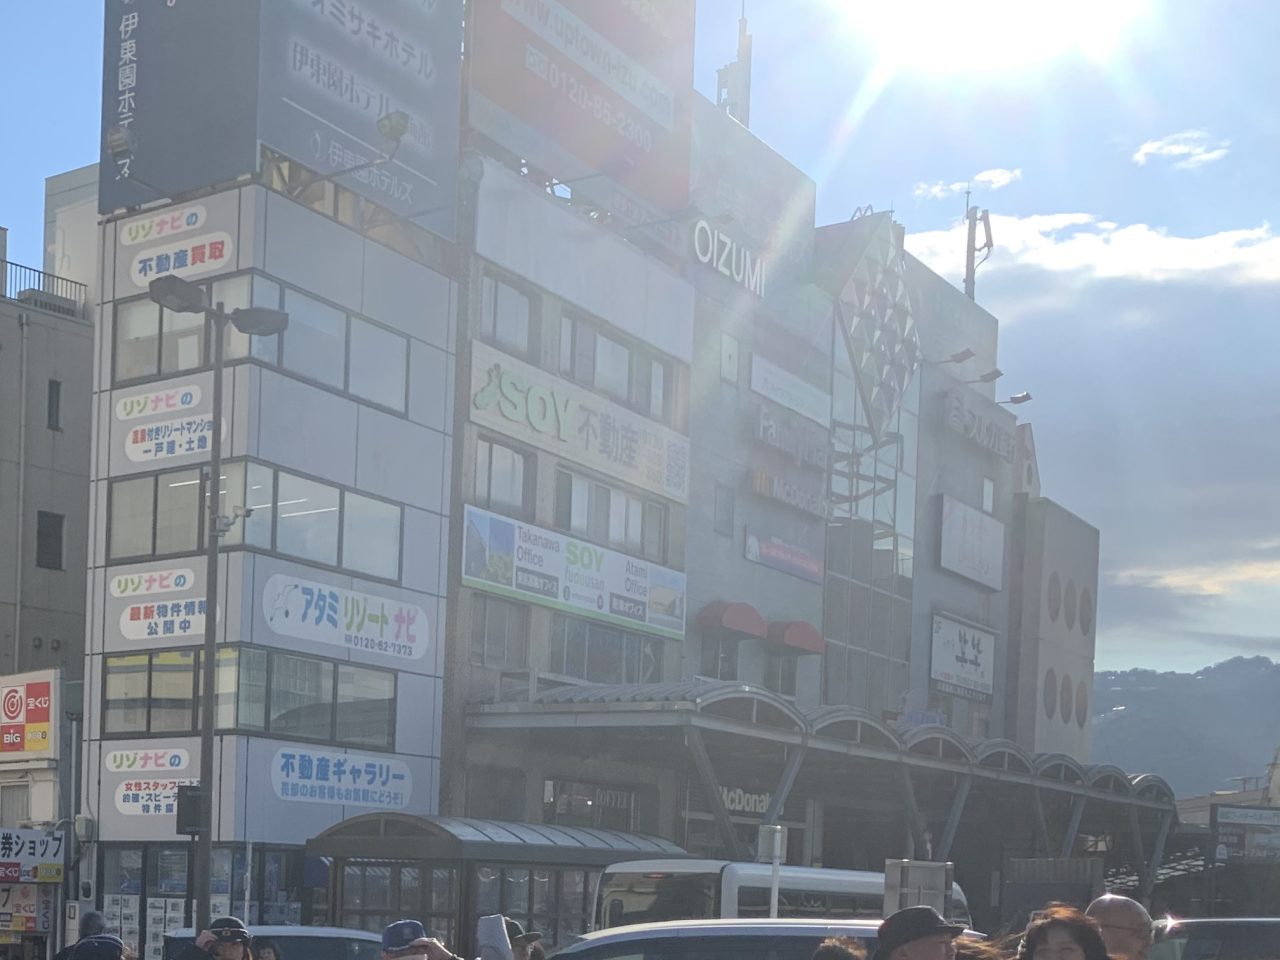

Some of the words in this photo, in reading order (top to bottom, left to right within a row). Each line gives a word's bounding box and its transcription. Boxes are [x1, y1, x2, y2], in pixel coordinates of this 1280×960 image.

[116, 12, 137, 181] 伊東園ホテズ
[128, 212, 198, 242] リゾナビの
[138, 240, 225, 277] 不動産買取
[694, 219, 766, 298] OIZUMI
[123, 392, 193, 417] リゾナビの
[117, 573, 187, 594] リゾナビの
[113, 752, 181, 769] リゾナビの
[280, 752, 406, 787] 不動産ギャラリー
